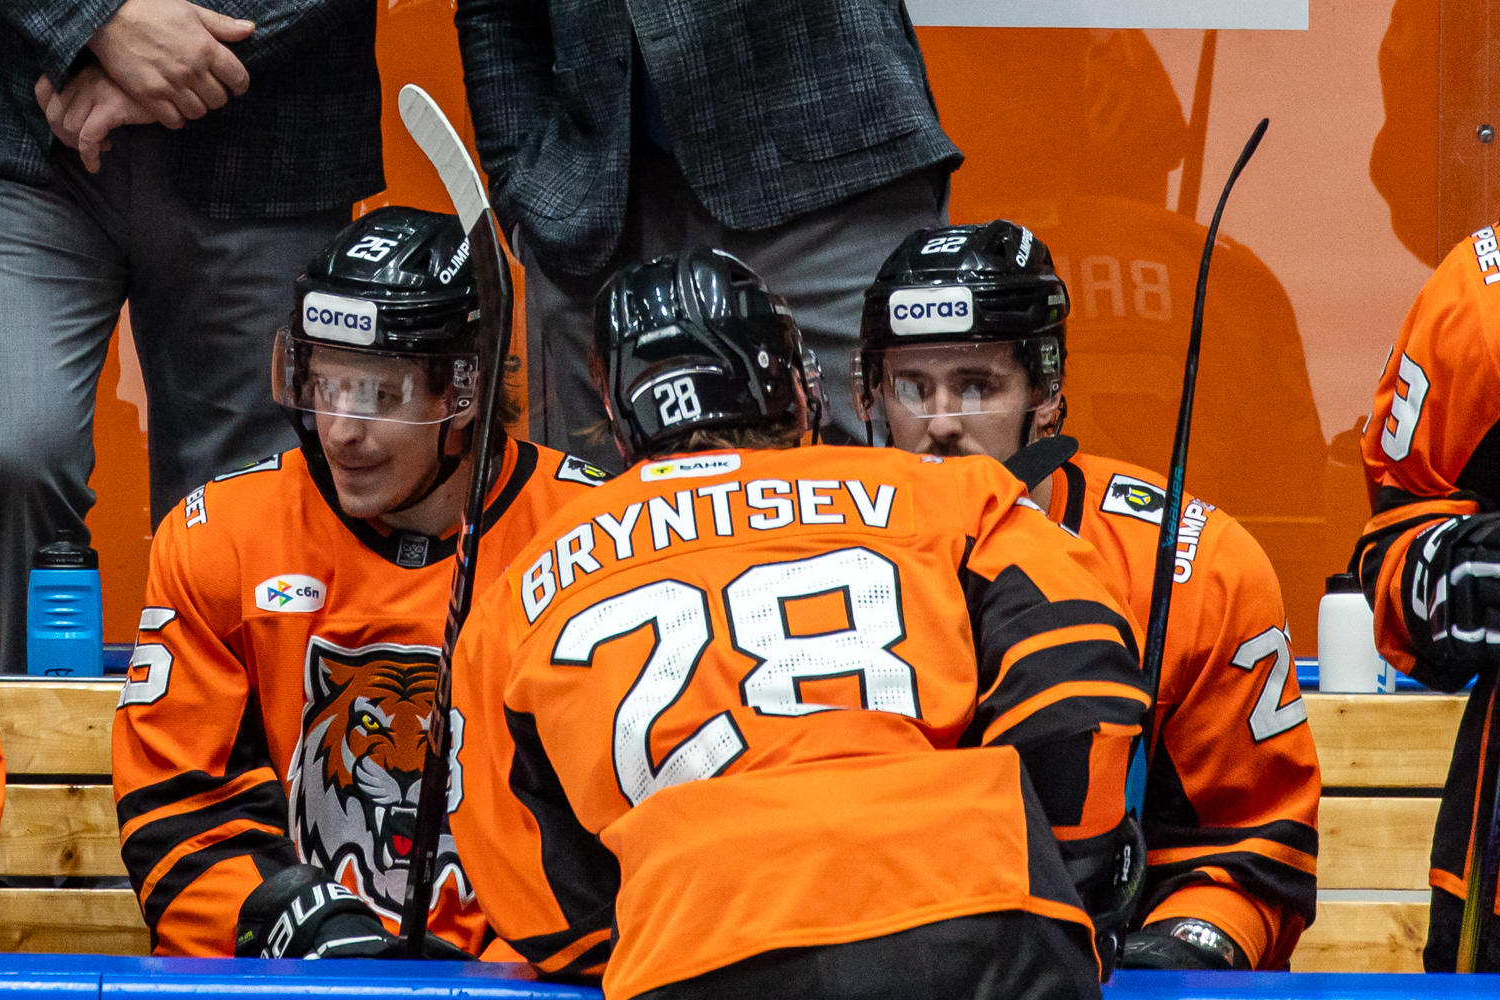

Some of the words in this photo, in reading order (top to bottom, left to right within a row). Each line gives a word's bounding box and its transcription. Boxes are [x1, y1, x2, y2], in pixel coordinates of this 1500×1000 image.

[346, 235, 398, 262] 25
[921, 236, 967, 255] 22
[439, 236, 470, 285] OLIMP
[306, 306, 372, 332] согаз
[894, 301, 969, 321] согаз
[654, 376, 701, 427] 28
[520, 479, 897, 625] BRYNTSEV
[296, 587, 320, 600] сбп
[550, 546, 923, 808] 28
